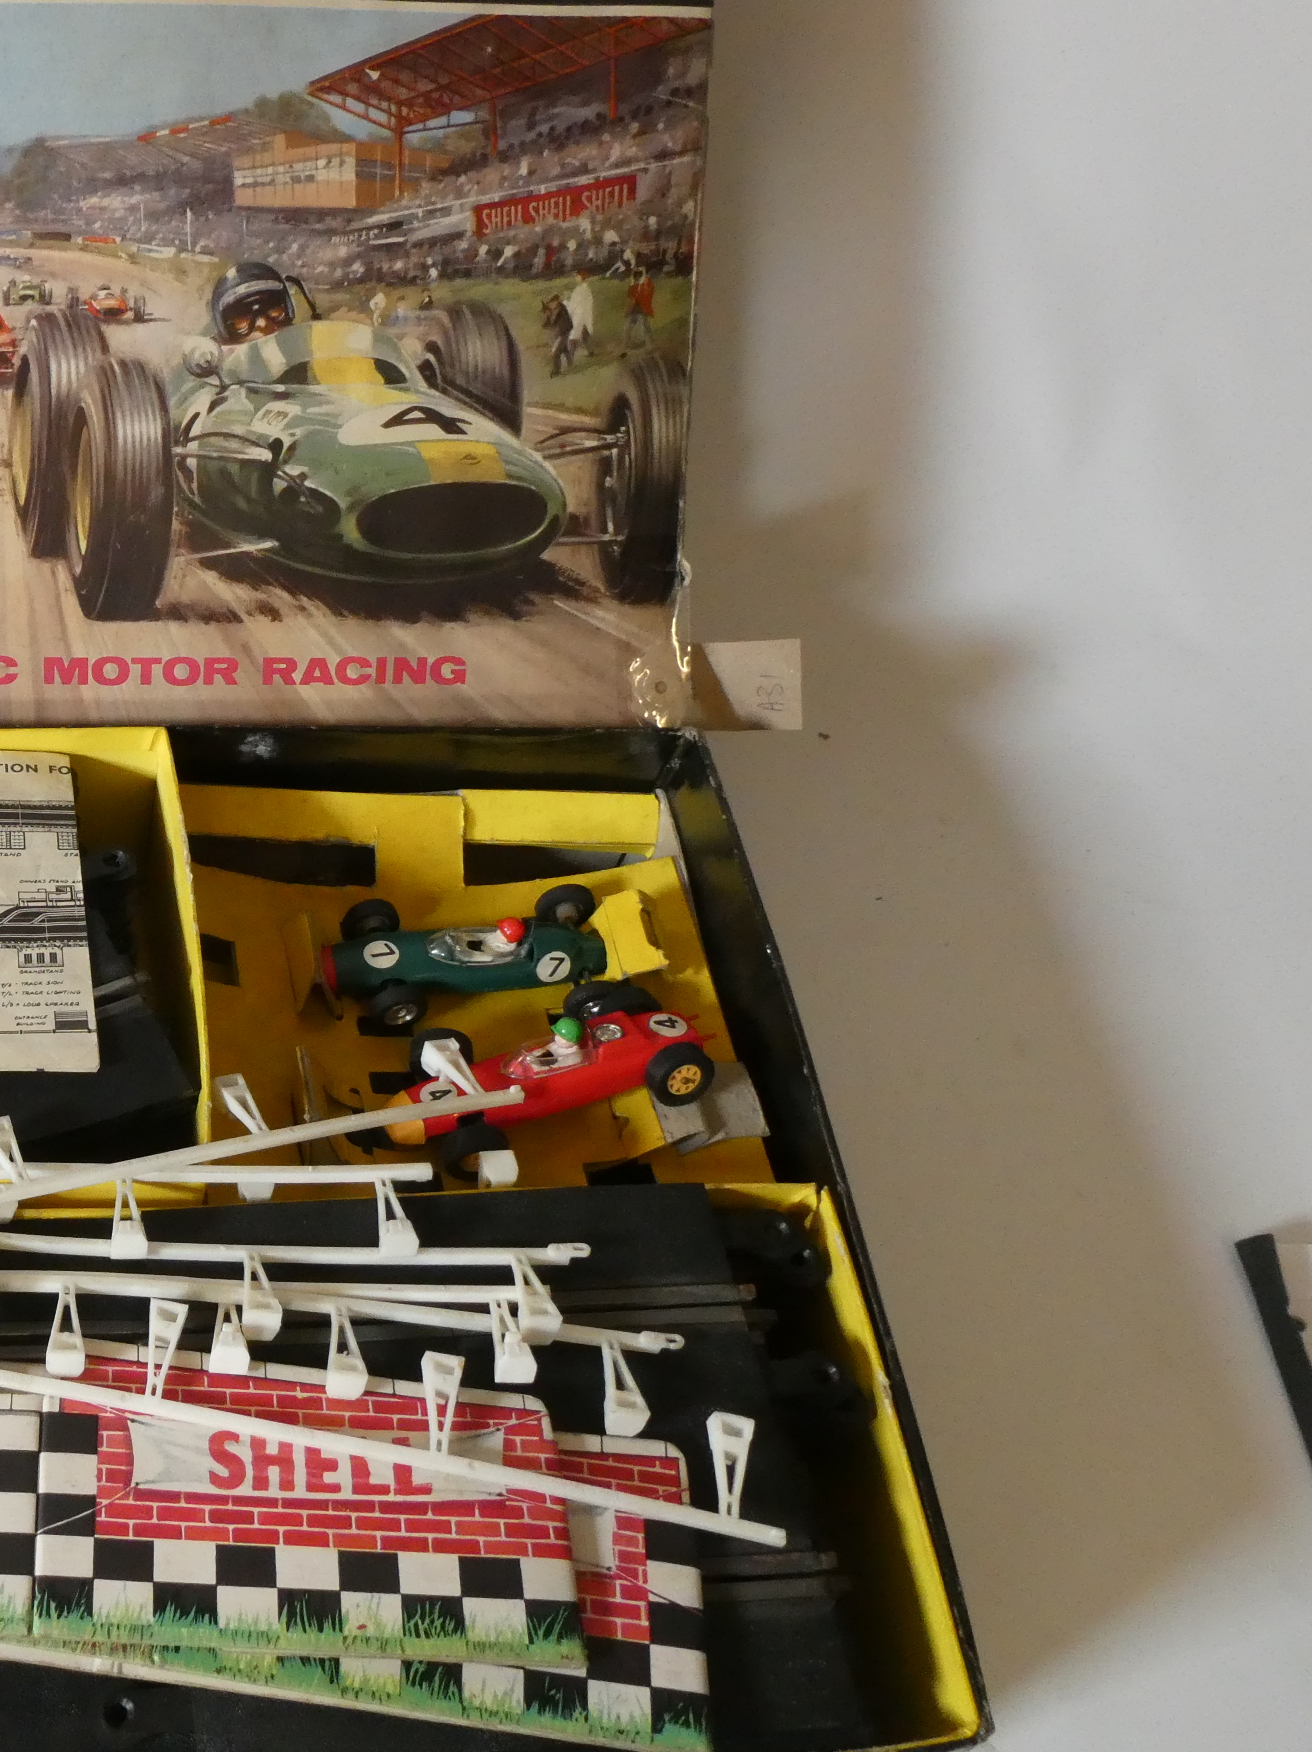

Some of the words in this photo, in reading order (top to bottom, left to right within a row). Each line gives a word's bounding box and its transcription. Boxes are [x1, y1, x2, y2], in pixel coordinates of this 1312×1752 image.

[380, 405, 473, 436] 4
[43, 655, 238, 687] MOTOR
[262, 655, 467, 687] RACING
[547, 955, 566, 978] 7
[208, 1430, 433, 1496] SHELL
